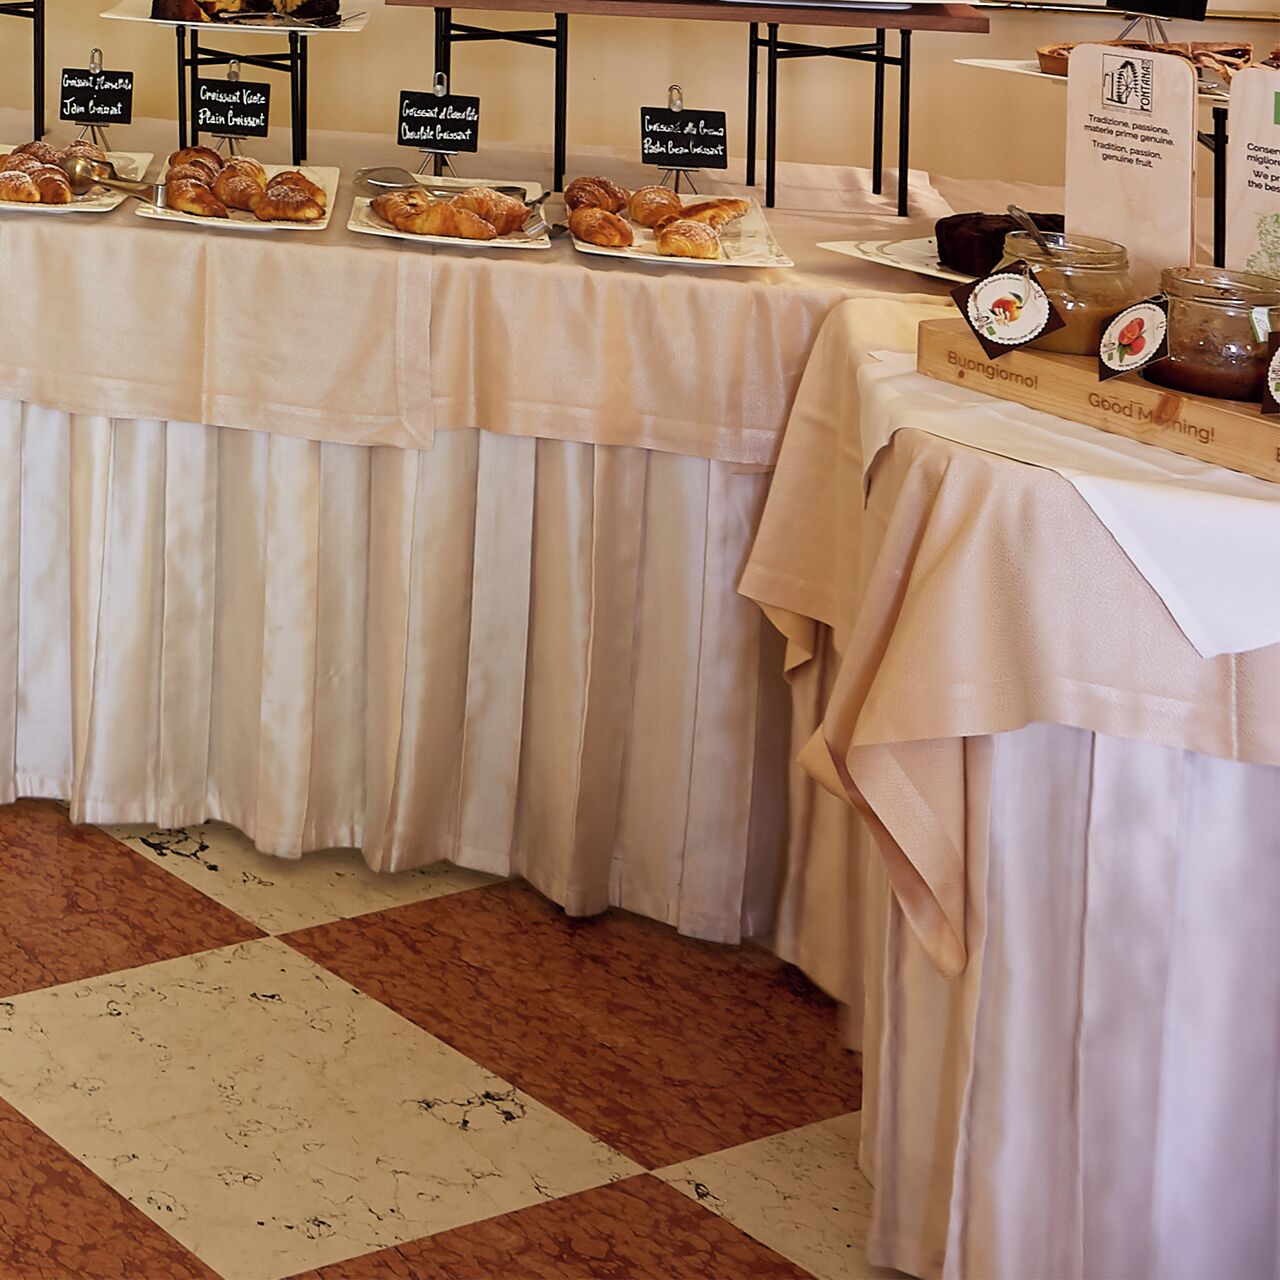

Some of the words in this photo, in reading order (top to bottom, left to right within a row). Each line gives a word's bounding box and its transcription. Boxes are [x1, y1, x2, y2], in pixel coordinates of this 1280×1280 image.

[63, 96, 85, 115] Jam
[198, 107, 225, 126] Plain
[1084, 124, 1114, 135] materie
[1115, 129, 1139, 140] prime
[1102, 152, 1134, 165] genuine
[1252, 168, 1269, 180] We
[1247, 179, 1263, 190] the
[947, 350, 1039, 389] Buongiorno!
[1088, 392, 1133, 418] Good
[1138, 406, 1215, 444] Mning!
